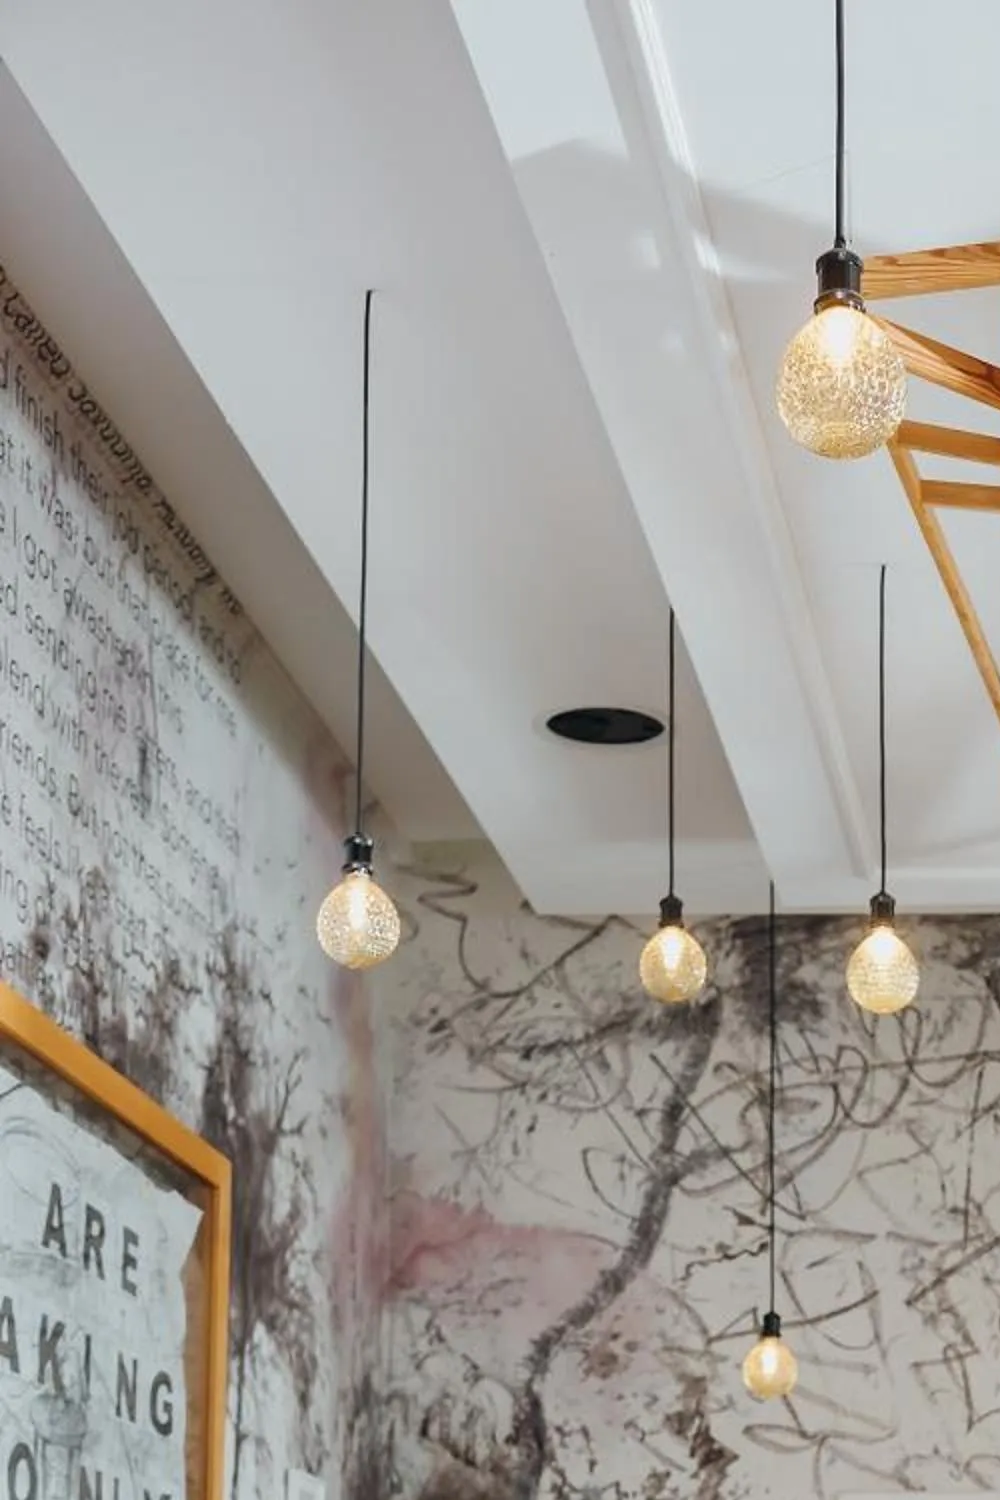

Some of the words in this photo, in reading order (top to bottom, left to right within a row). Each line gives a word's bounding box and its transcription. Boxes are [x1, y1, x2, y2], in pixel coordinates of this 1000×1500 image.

[14, 364, 64, 461] finish
[70, 443, 107, 513] their
[112, 500, 138, 554] job
[21, 448, 32, 494] it
[23, 534, 58, 593] got
[25, 602, 97, 713] sending
[51, 698, 87, 758] with
[20, 794, 61, 869] feels
[68, 773, 96, 837] But
[41, 1183, 139, 1297] ARE
